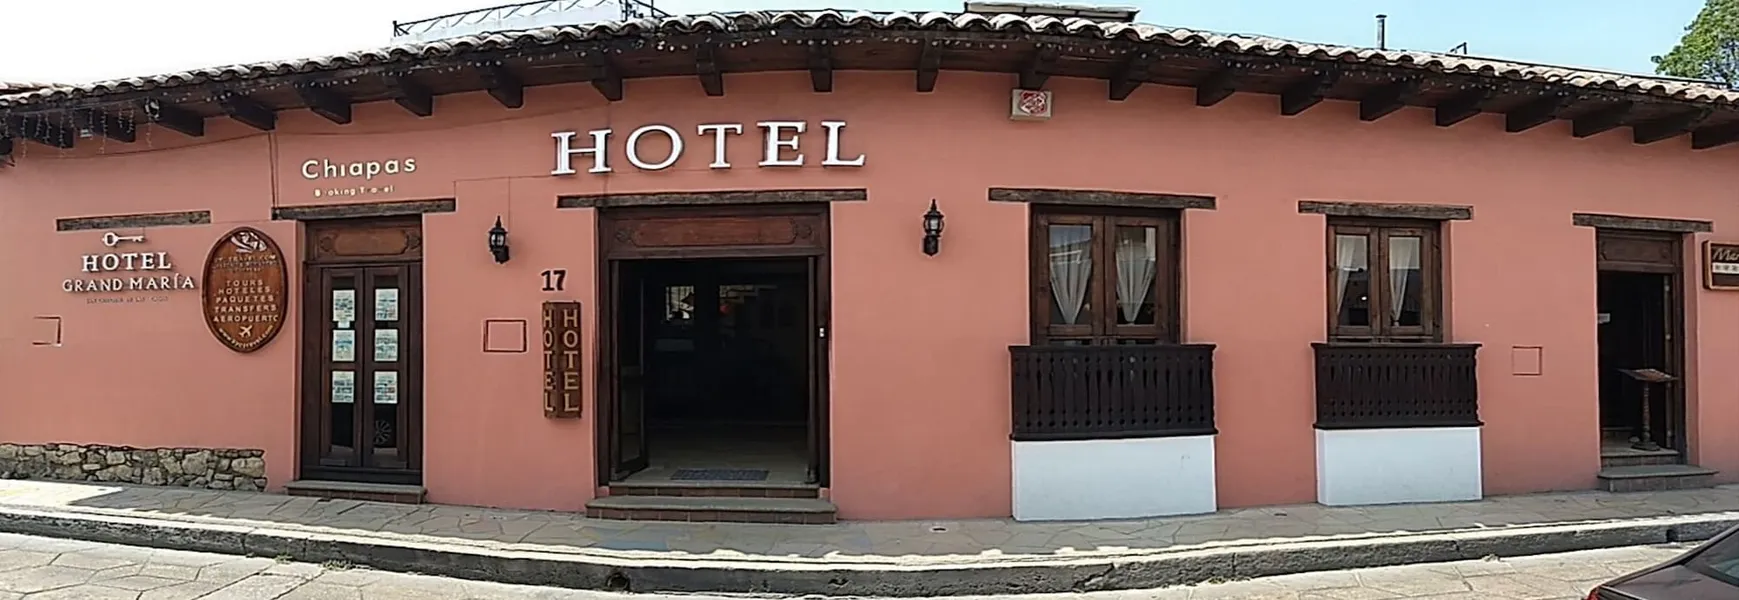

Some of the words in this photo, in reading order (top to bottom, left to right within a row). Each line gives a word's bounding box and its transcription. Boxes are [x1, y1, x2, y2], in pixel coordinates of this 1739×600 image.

[550, 121, 866, 175] HOTEL
[302, 157, 417, 180] Chiapas
[314, 187, 356, 197] Boking
[81, 252, 172, 272] HOTEL
[62, 278, 123, 292] GRAND
[129, 272, 195, 290] MARÍA
[218, 286, 271, 295] HOTELES
[226, 279, 264, 287] TOURS
[541, 269, 567, 292] 17
[214, 303, 277, 313] TRANSFERS
[215, 294, 275, 304] PAQUETES
[212, 314, 279, 323] AEROPUERTO
[543, 308, 554, 412] HOTEL
[563, 308, 580, 412] HOTEL
